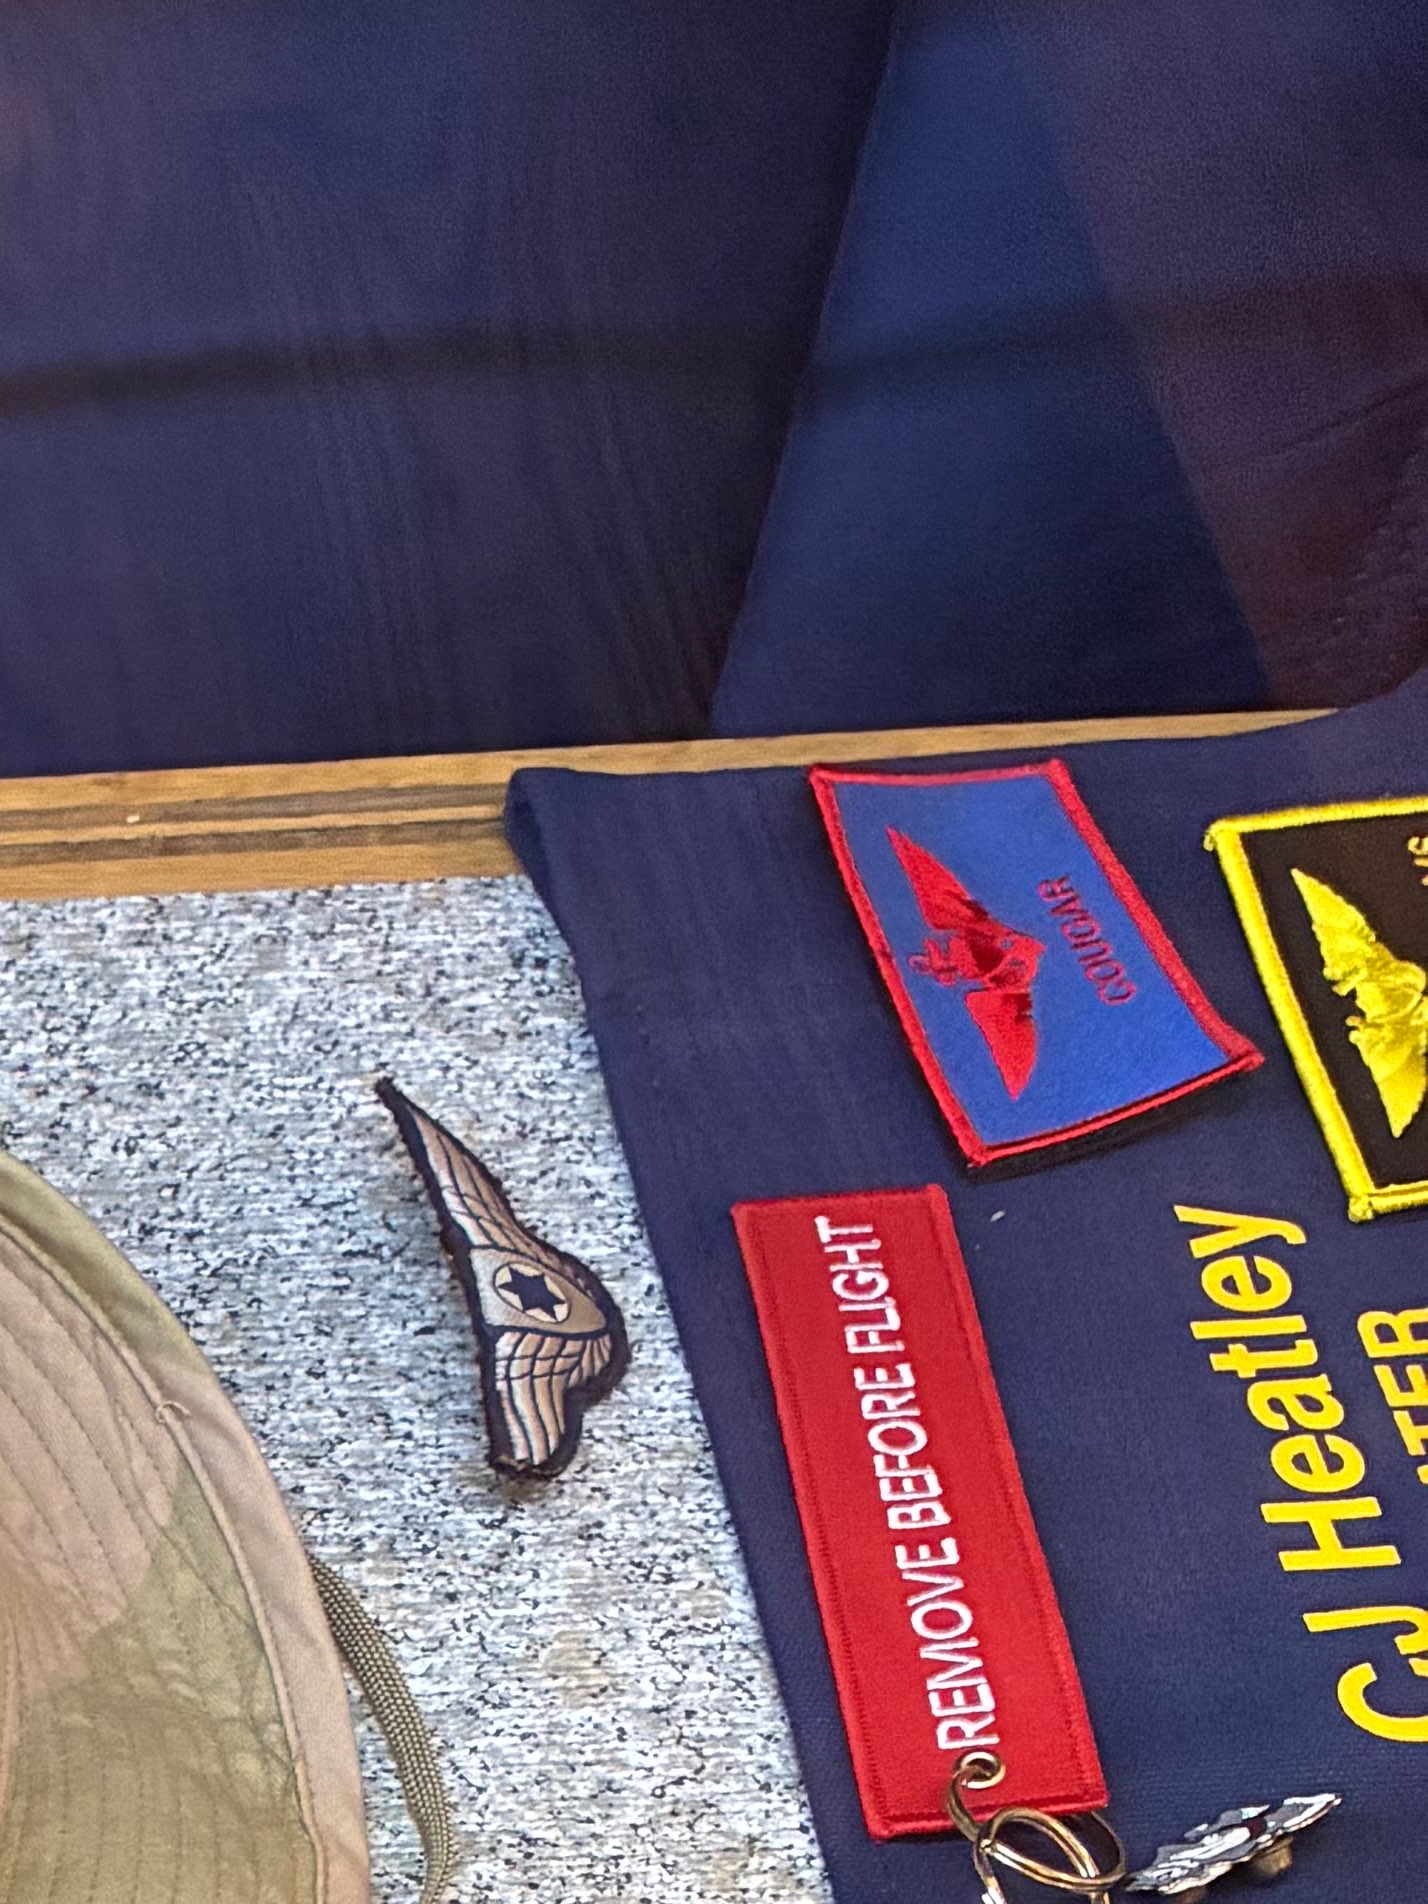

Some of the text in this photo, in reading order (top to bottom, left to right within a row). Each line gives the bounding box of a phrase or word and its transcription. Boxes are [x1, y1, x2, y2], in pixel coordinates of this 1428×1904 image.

[1037, 873, 1137, 1006] COUGAR
[814, 1216, 1000, 1750] REMOVE BEFORE FLIGHT
[1173, 1204, 1401, 1572] Heatley
